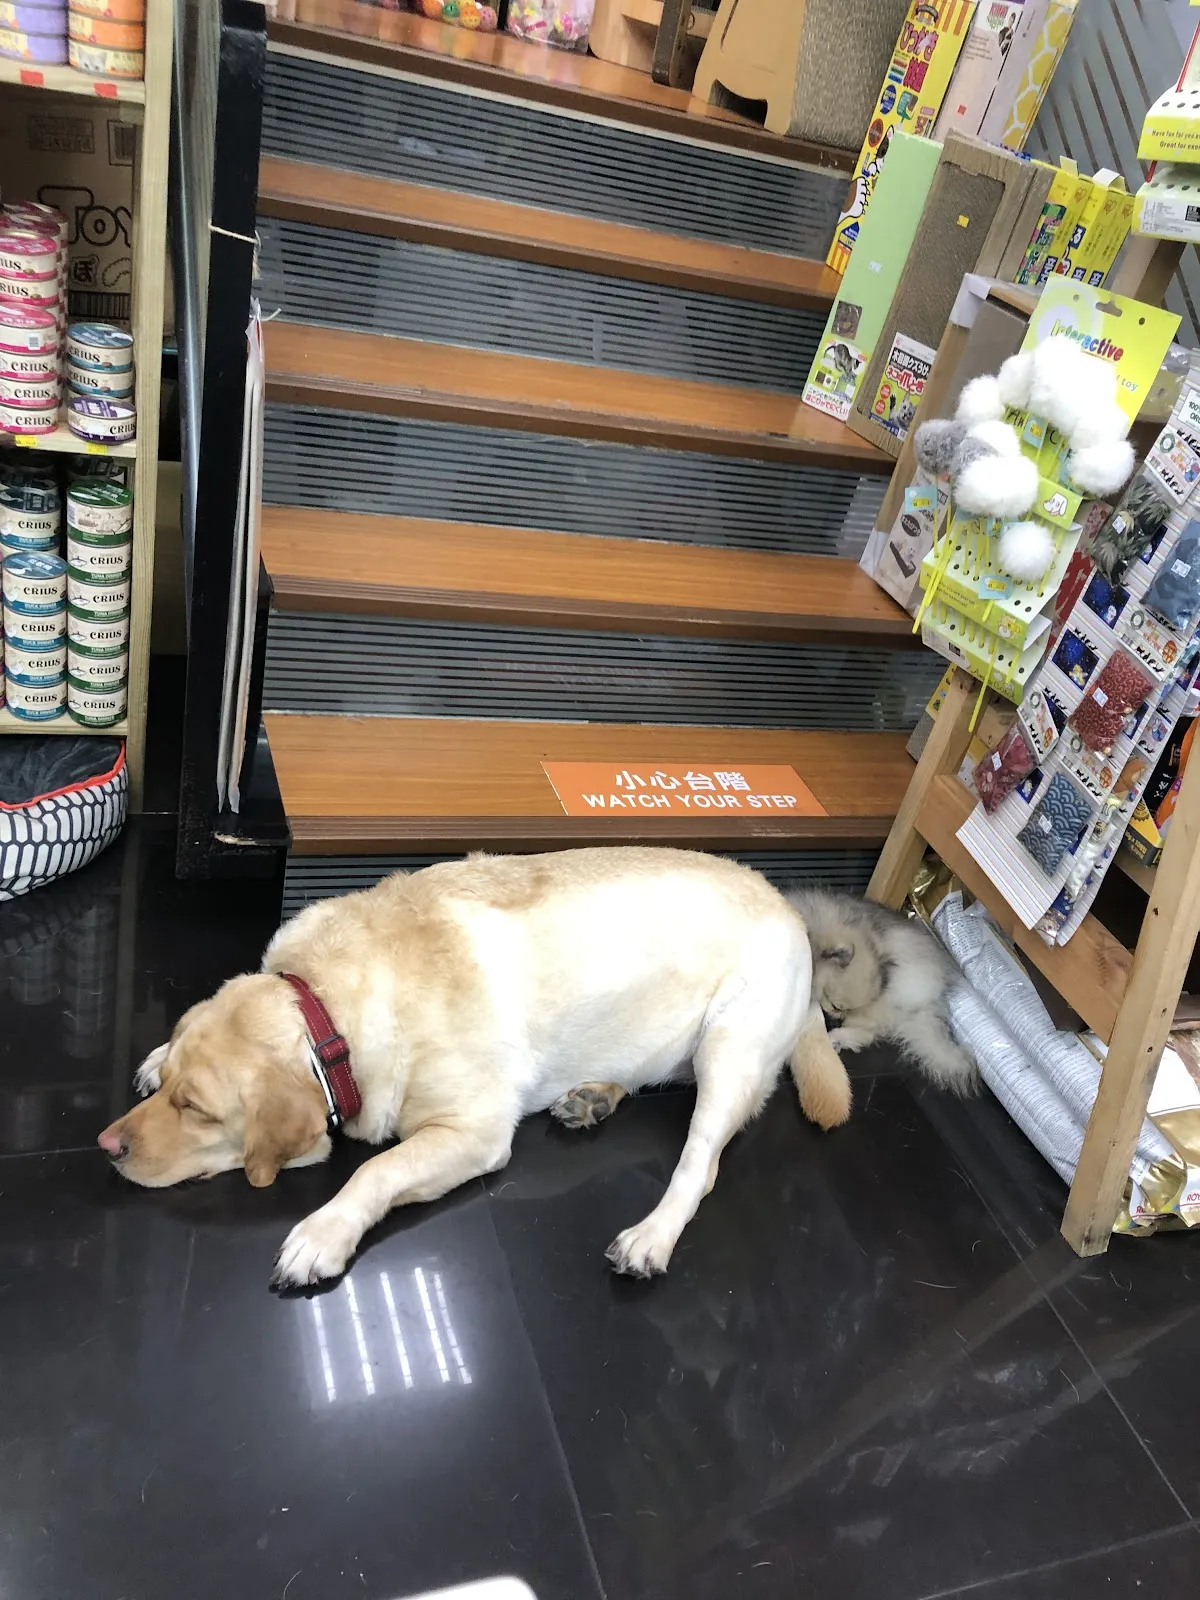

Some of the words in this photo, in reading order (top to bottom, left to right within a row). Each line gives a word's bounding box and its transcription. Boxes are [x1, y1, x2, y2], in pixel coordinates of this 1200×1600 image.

[69, 345, 100, 363] CRIUS
[11, 361, 49, 372] CRIUS
[1121, 378, 1138, 392] toy
[14, 388, 51, 399] CRIUS
[15, 416, 51, 426] CRIUS
[18, 520, 52, 529] CRIUS
[90, 556, 123, 565] CRIUS
[24, 587, 58, 595] CRIUS
[93, 593, 124, 603] CRIUS
[21, 624, 56, 632] CRIUS
[90, 630, 122, 640] CRIUS
[28, 659, 61, 668] CRIUS
[89, 665, 121, 675] CRIUS
[25, 694, 57, 703] CRIUS
[83, 701, 116, 709] CRIUS
[615, 770, 752, 791] 小心台階
[582, 793, 671, 808] WATCH
[674, 793, 743, 808] YOUR
[746, 794, 798, 808] STEP
